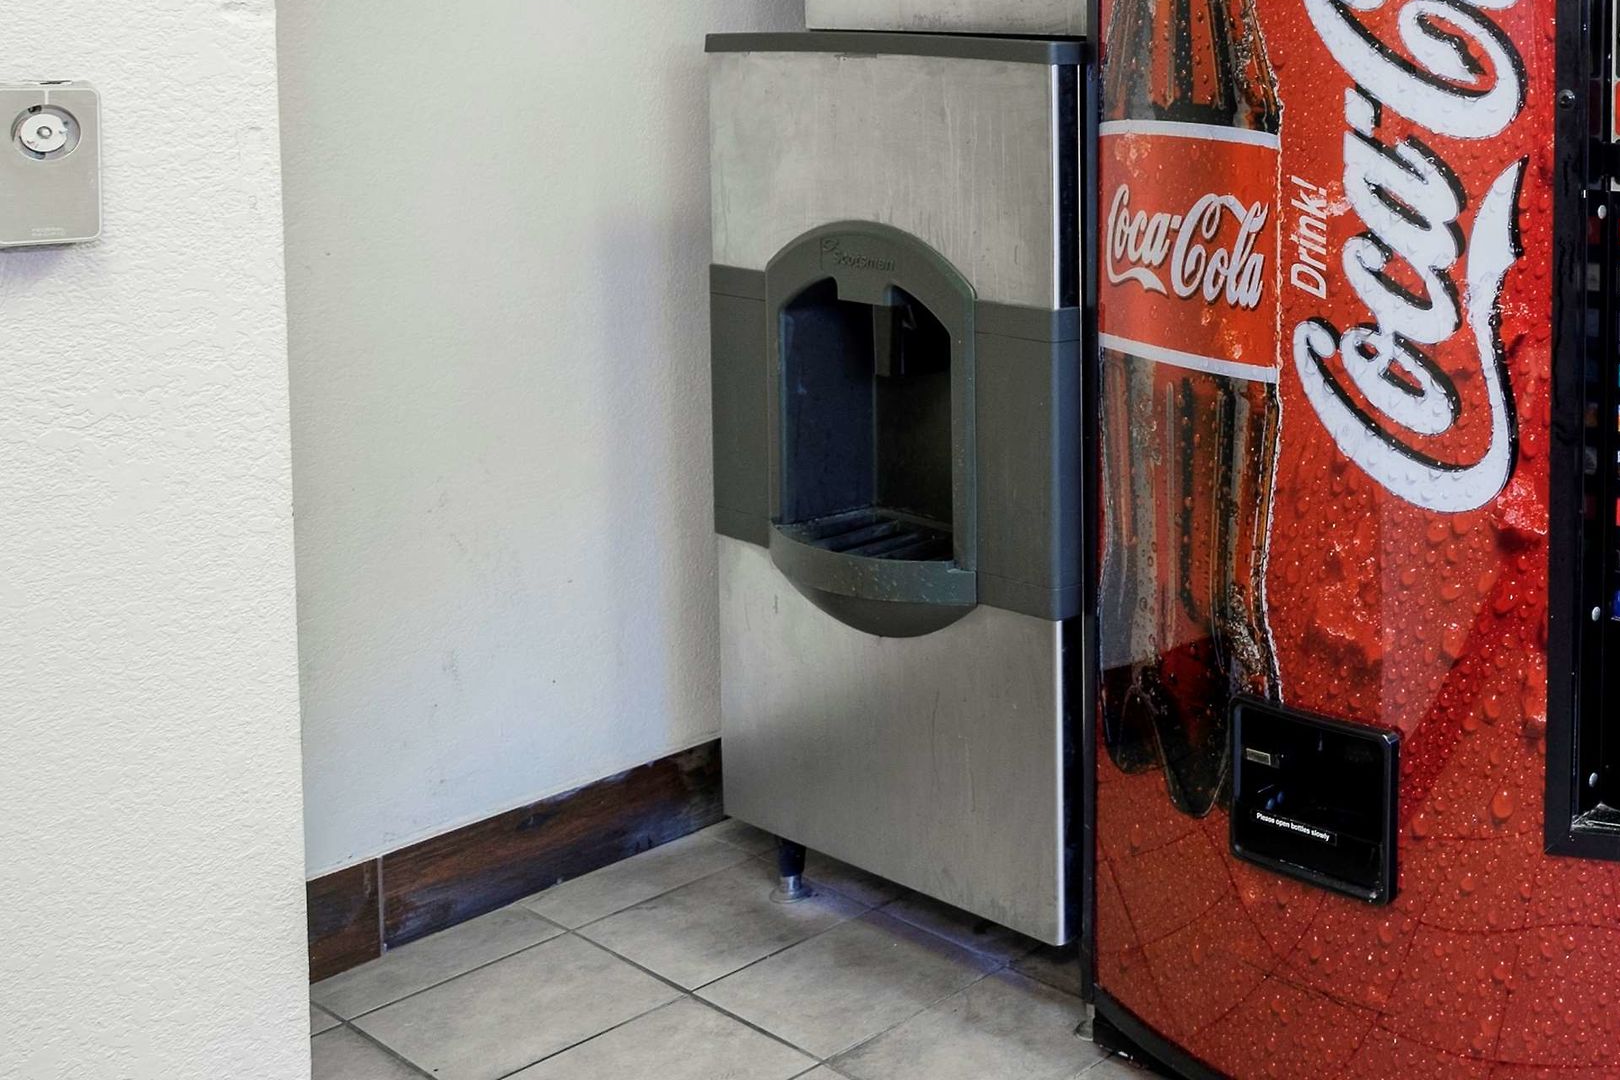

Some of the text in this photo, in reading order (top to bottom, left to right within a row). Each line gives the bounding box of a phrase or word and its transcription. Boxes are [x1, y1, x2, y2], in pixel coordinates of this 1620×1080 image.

[1106, 181, 1269, 310] Coca-Cola
[1289, 177, 1329, 300] Drink!
[1256, 811, 1330, 842] Please open bottles slowly
